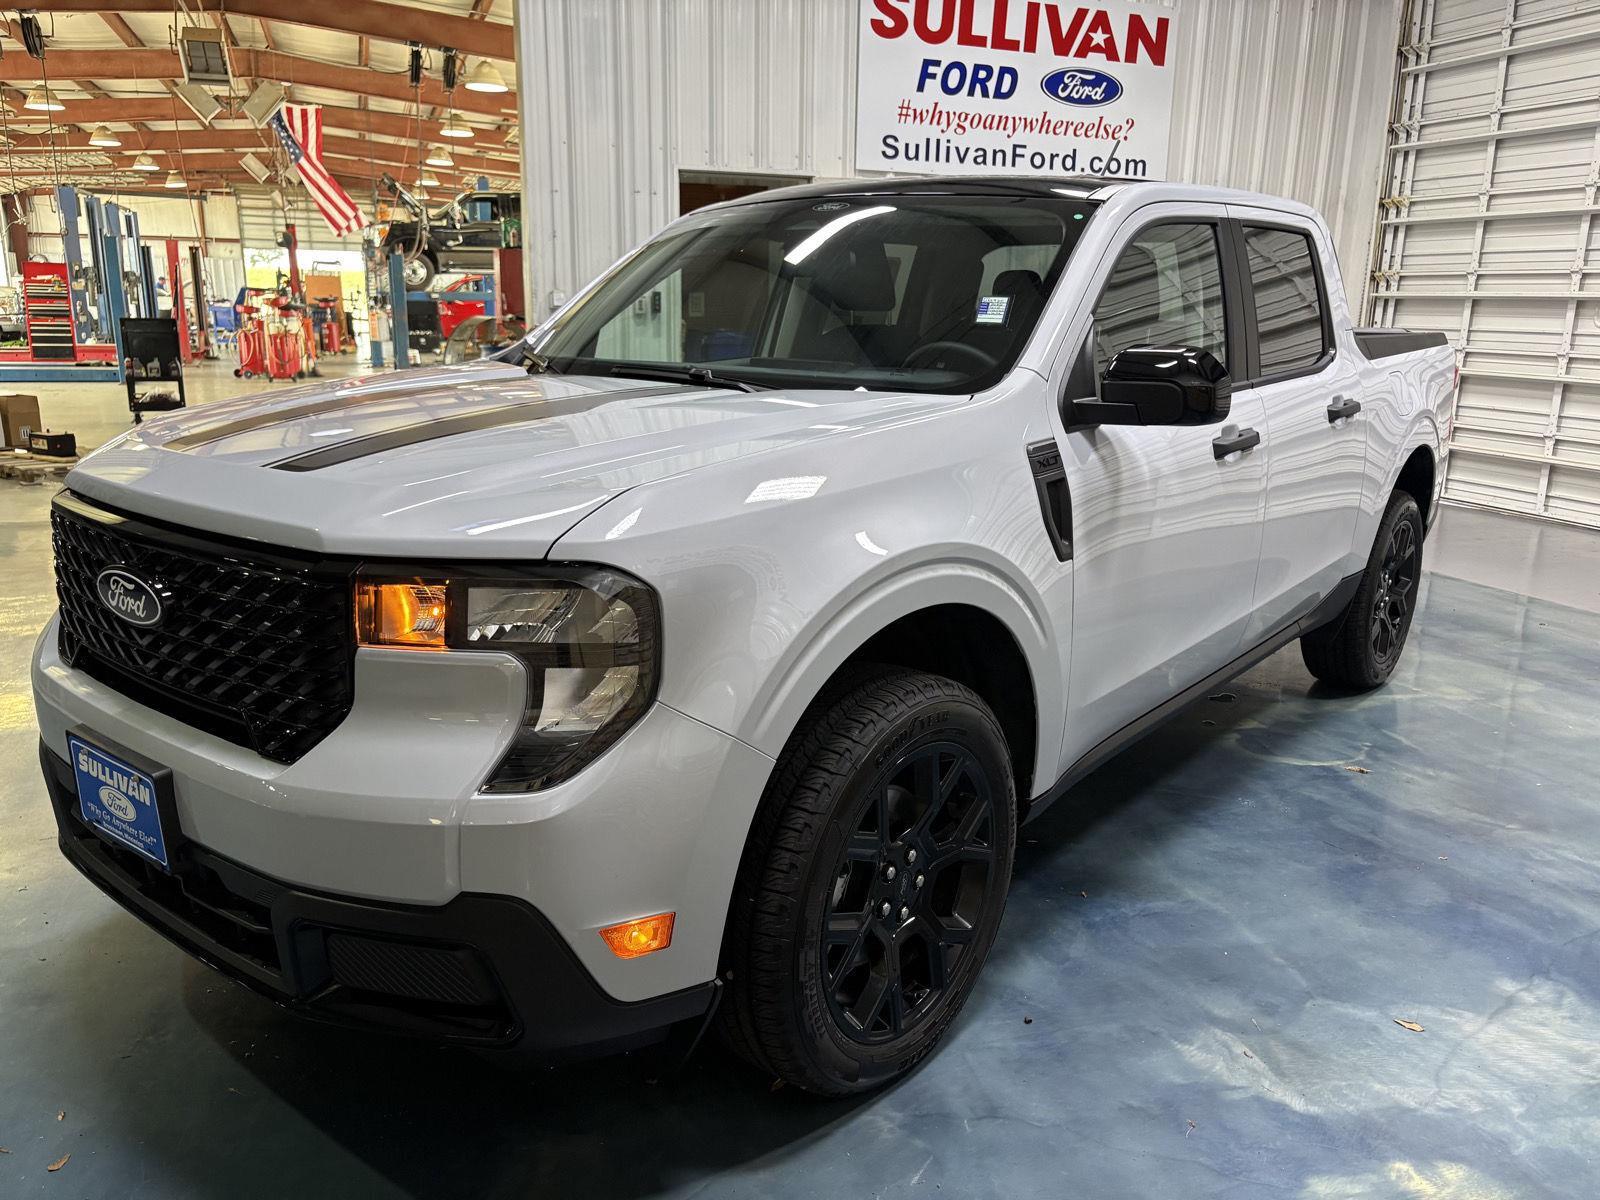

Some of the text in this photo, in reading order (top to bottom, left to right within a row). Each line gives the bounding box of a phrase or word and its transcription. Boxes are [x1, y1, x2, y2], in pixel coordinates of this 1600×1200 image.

[870, 0, 1169, 67] SULLIVAN
[916, 58, 1019, 100] FORD
[1056, 70, 1108, 103] Ford
[897, 98, 1135, 141] #whygoanywhereelse?
[880, 134, 1147, 177] SullivanFord.com
[108, 576, 147, 618] Ford
[79, 752, 151, 806] SULLIVAN
[107, 791, 129, 818] Ford
